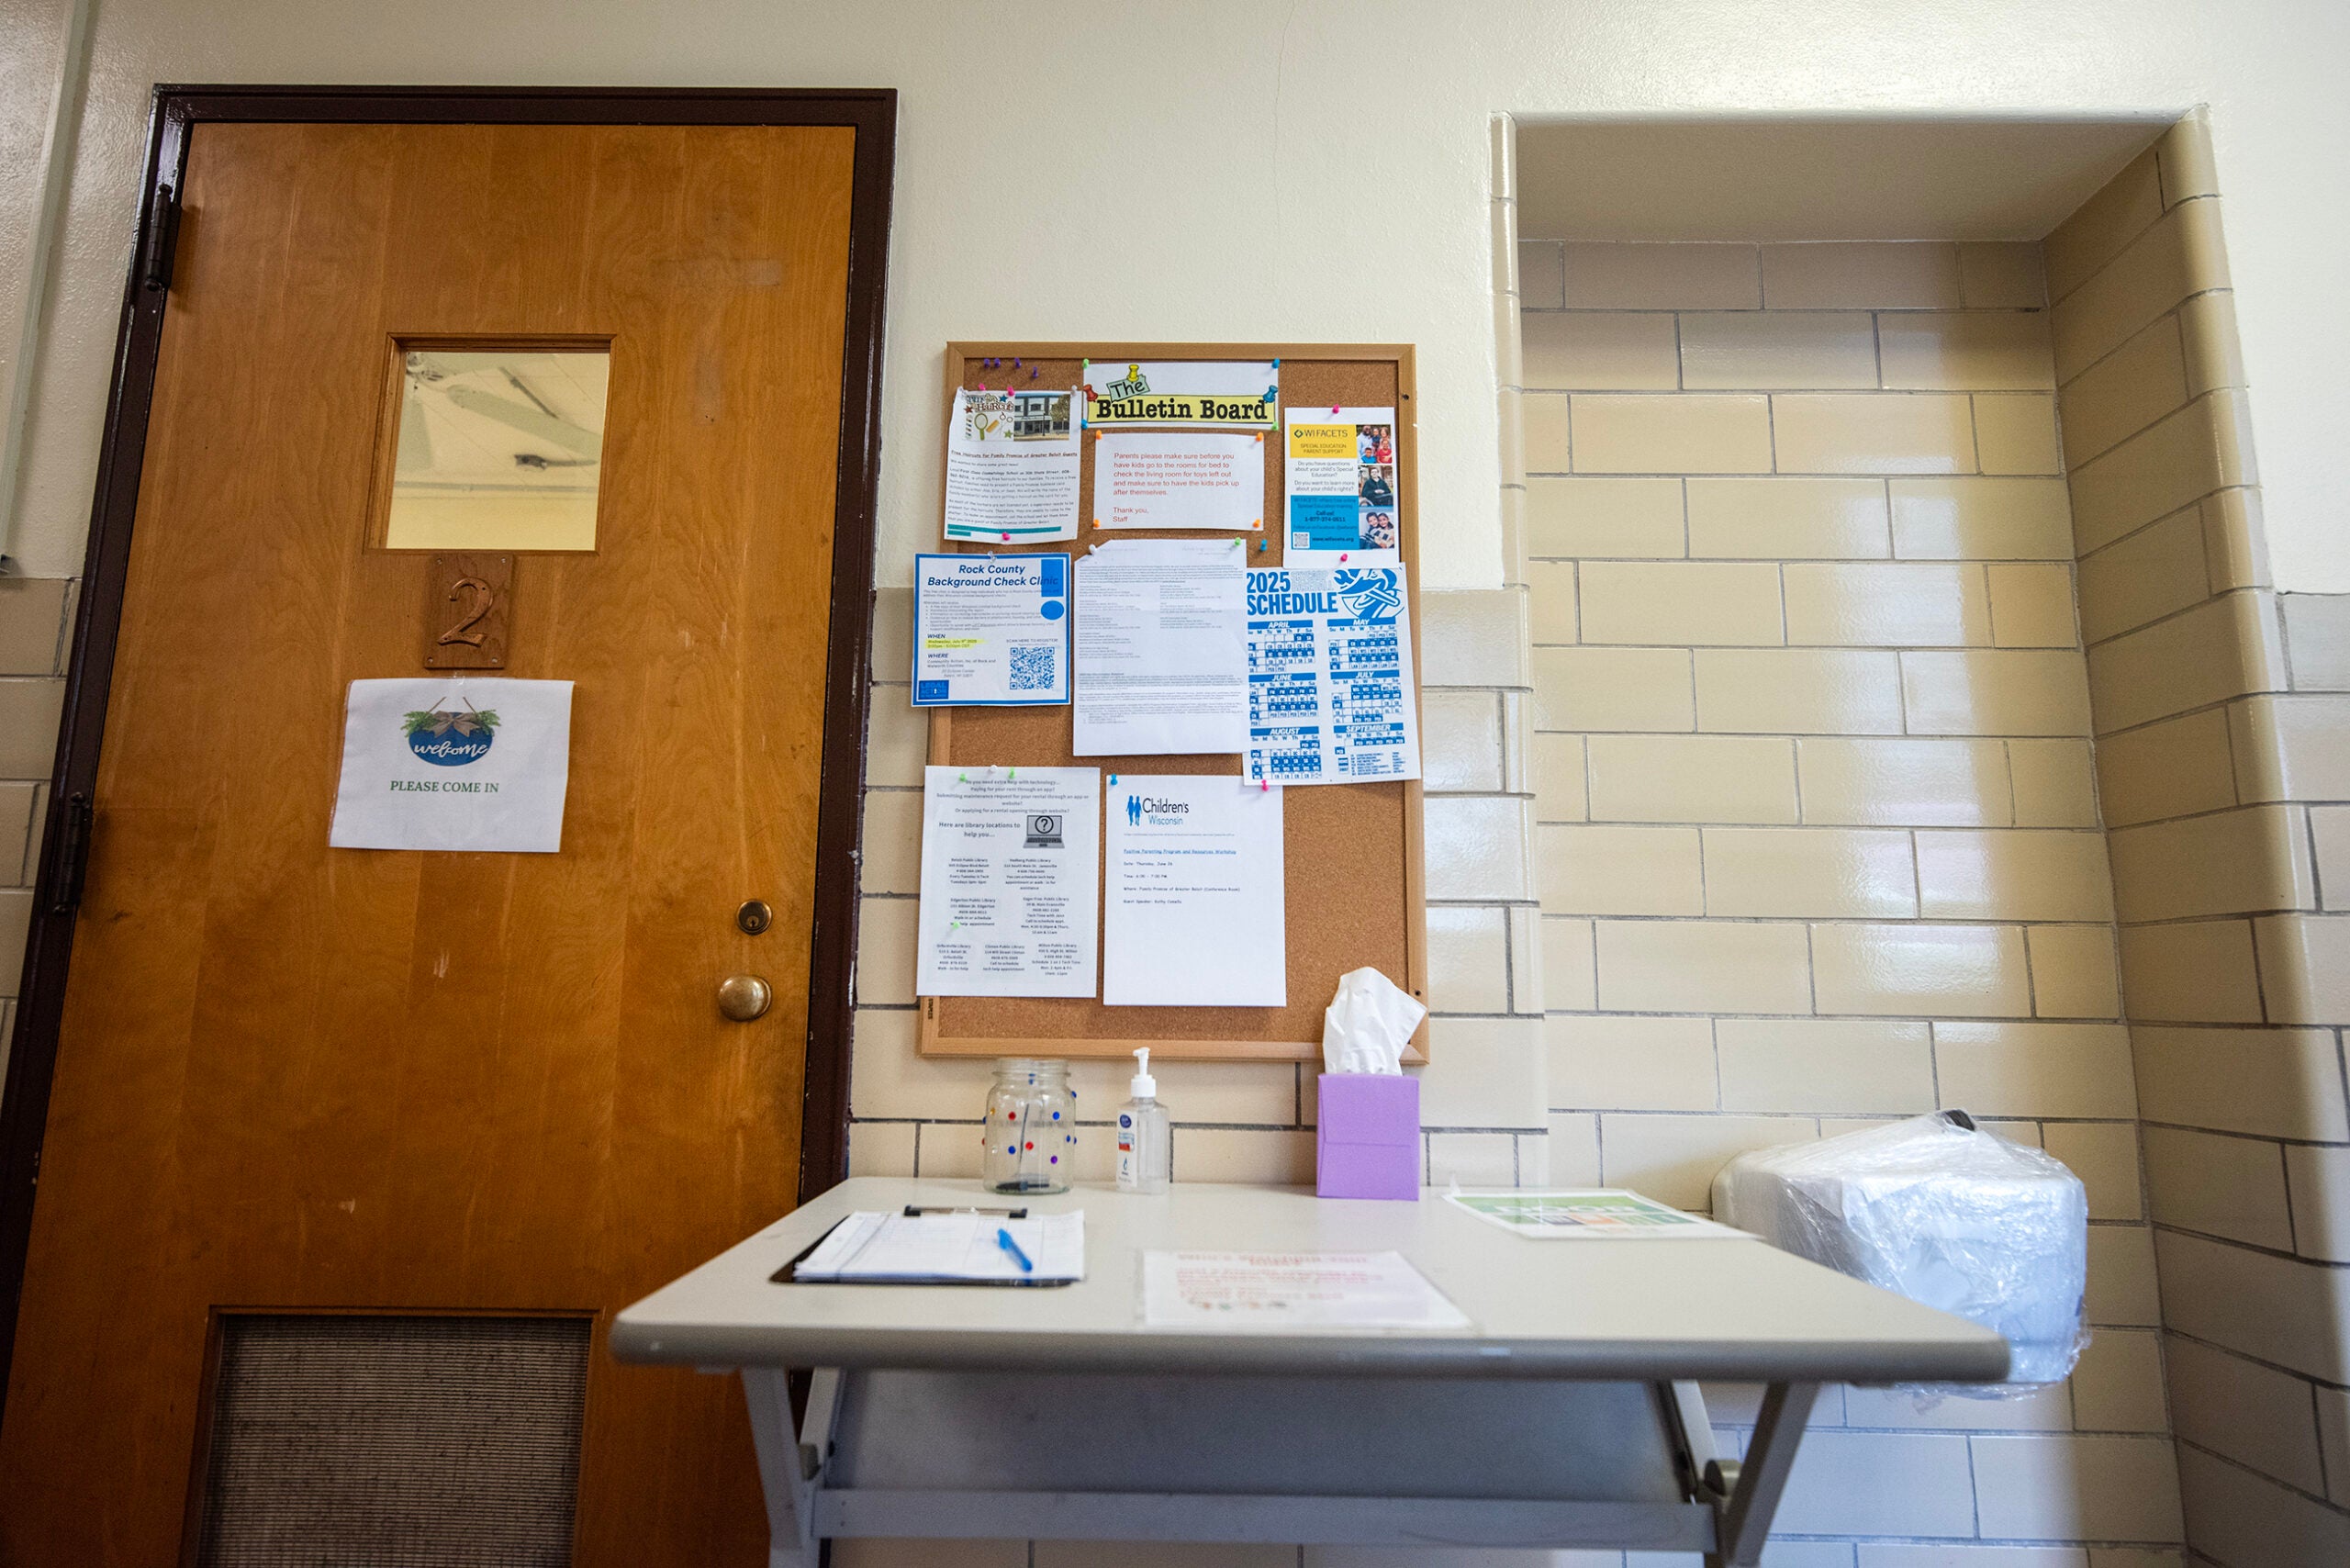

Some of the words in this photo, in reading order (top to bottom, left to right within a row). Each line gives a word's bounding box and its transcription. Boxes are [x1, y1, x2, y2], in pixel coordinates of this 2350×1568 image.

[1110, 381, 1145, 398] The
[1096, 398, 1192, 419] Bulletin
[1200, 399, 1267, 420] Board
[958, 565, 984, 574] Rock
[988, 565, 1025, 575] County
[927, 577, 991, 588] Background
[994, 577, 1025, 586] Check
[1030, 577, 1058, 585] Clinic
[1247, 571, 1291, 593] 2025
[1248, 592, 1338, 615] SCHEDULE
[437, 577, 494, 647] 2
[413, 741, 489, 756] welcome
[390, 780, 439, 791] PLEASE
[442, 782, 481, 792] COME
[485, 783, 498, 793] IN
[1143, 798, 1189, 813] Children's
[1148, 815, 1182, 825] Wisconsin
